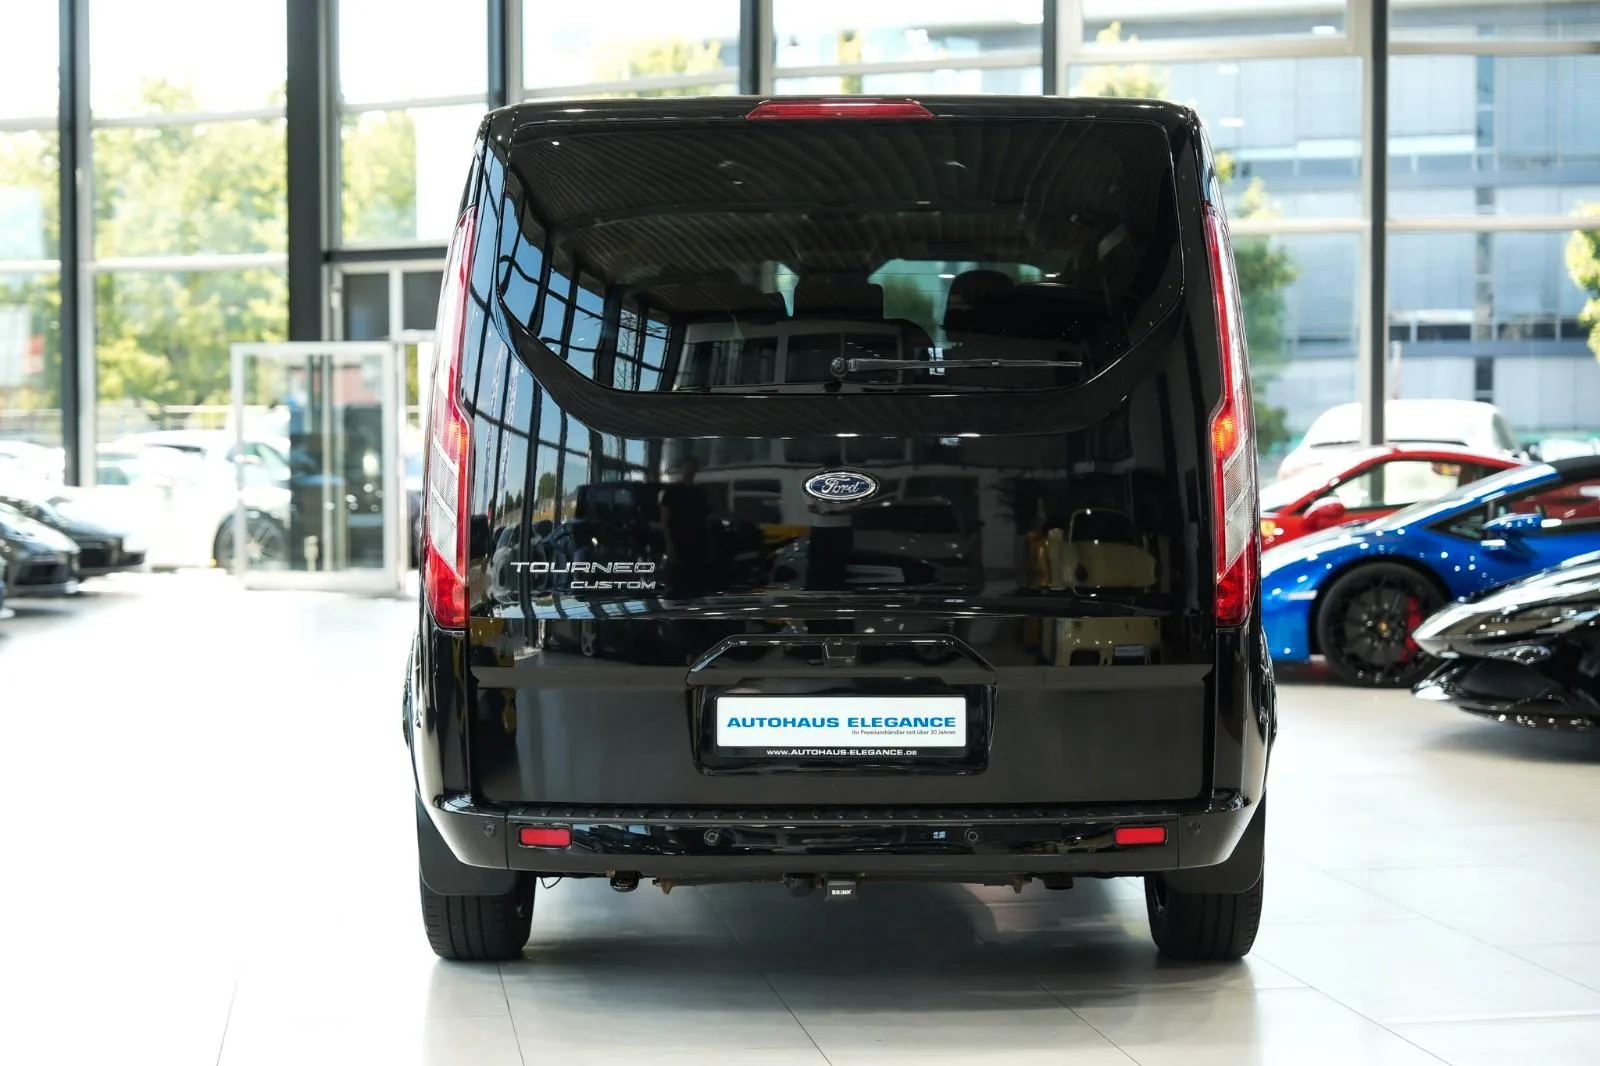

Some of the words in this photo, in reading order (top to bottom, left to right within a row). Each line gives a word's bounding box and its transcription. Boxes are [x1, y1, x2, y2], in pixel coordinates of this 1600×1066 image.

[822, 478, 860, 493] Ford
[510, 562, 655, 573] TOURNEO
[571, 581, 656, 589] CUSTOM
[727, 717, 840, 728] AUTOHAUS
[847, 717, 956, 728] ELEGANCE
